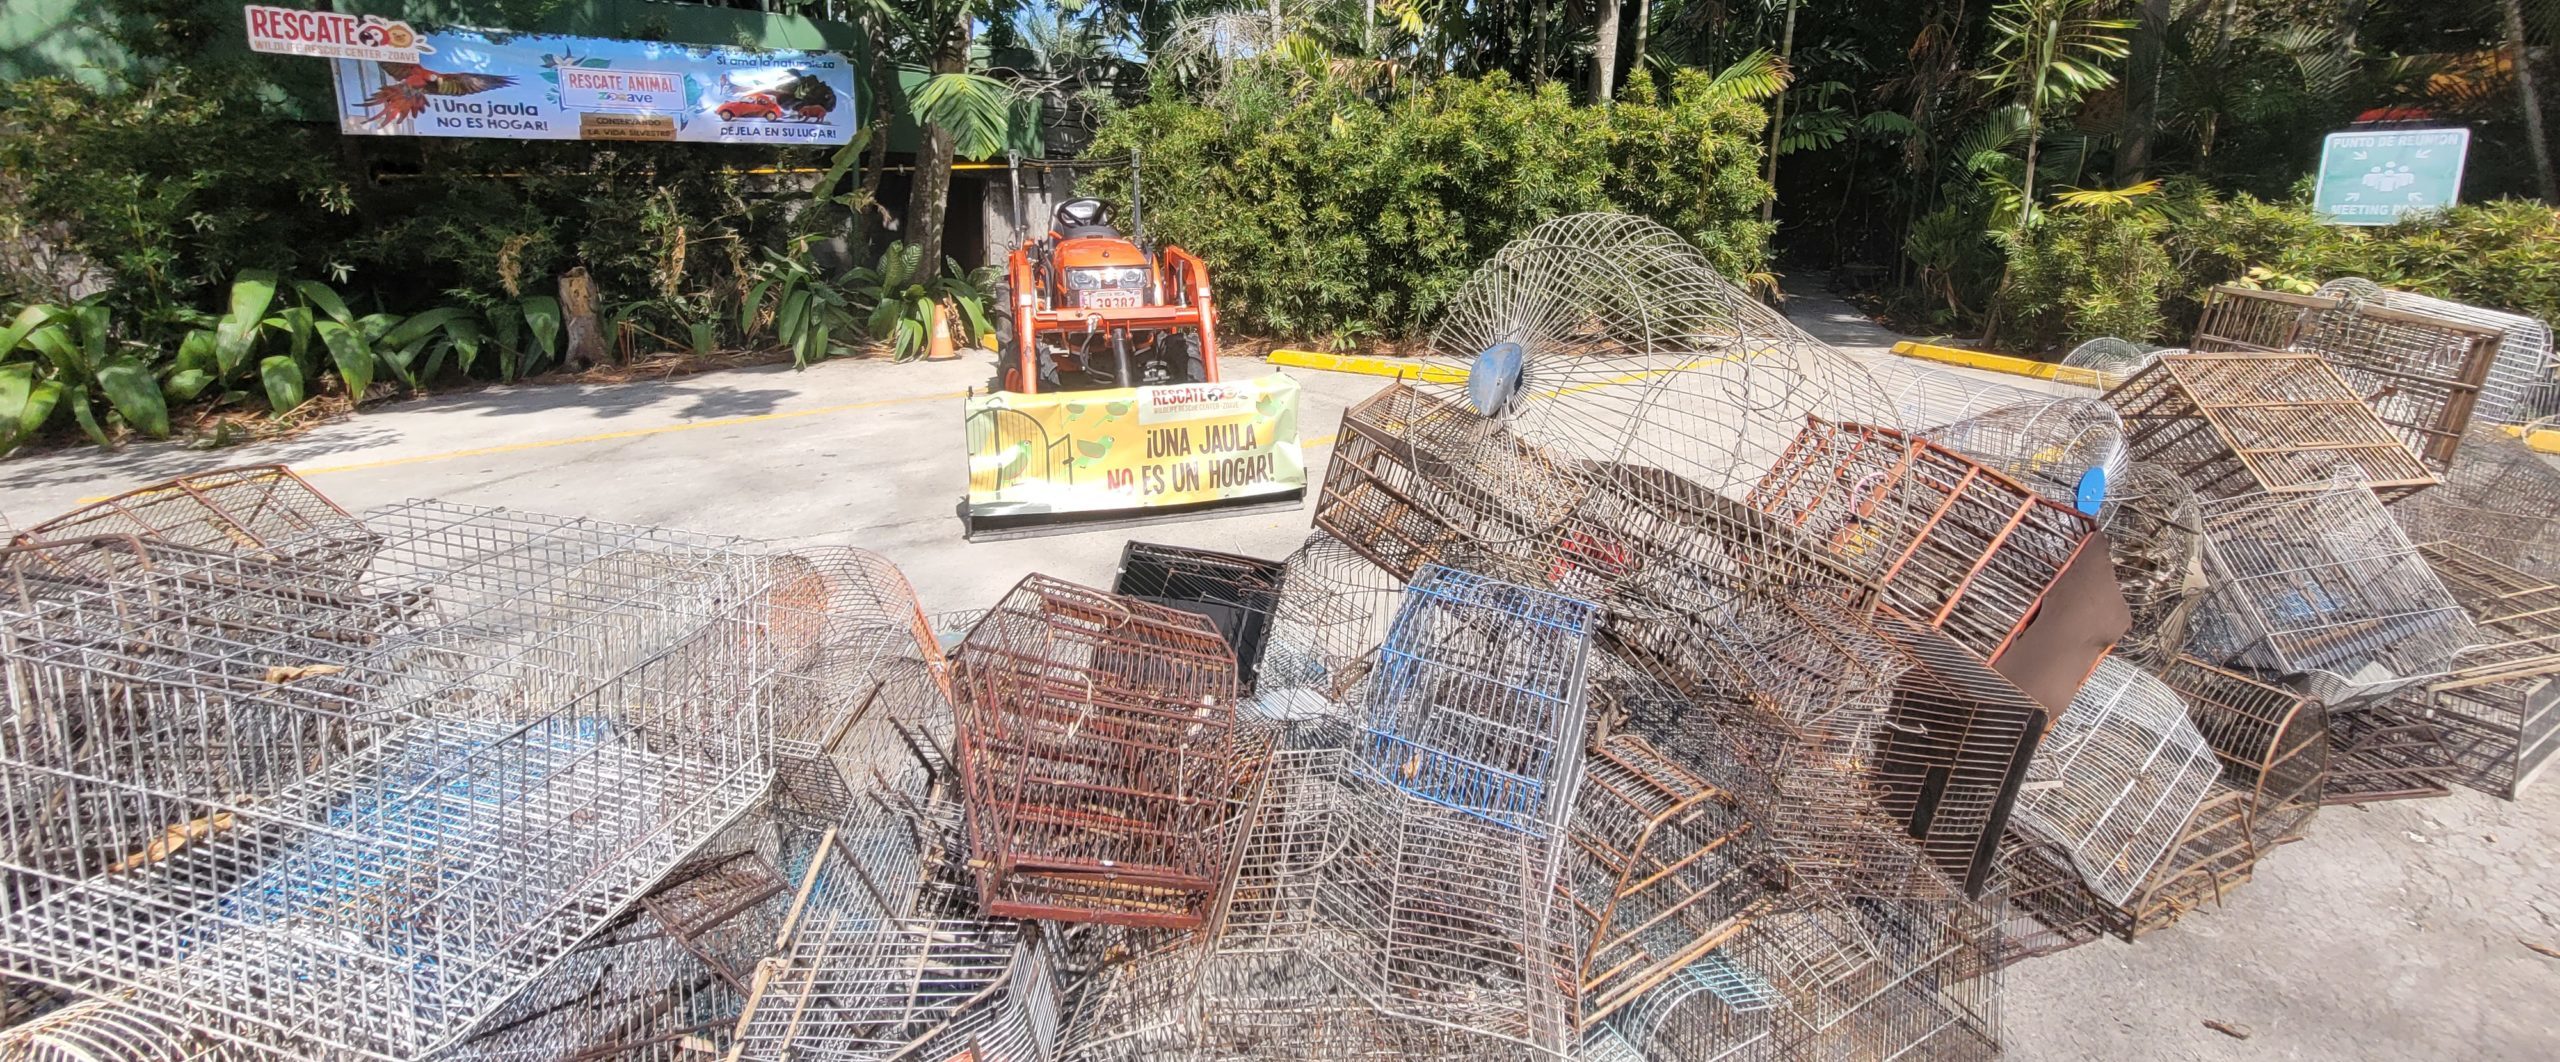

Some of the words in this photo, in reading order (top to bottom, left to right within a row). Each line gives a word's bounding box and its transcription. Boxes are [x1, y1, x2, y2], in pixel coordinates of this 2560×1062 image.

[251, 9, 357, 46] RESCATE
[304, 43, 342, 56] RESCUE
[344, 47, 382, 59] CENTER
[388, 52, 418, 62] ZOAVE
[568, 73, 623, 91] RESCATE
[628, 76, 677, 93] ANIMAL
[486, 100, 539, 118] jaula
[436, 117, 462, 128] NO
[466, 117, 484, 129] ES
[487, 119, 549, 132] HOGAR!
[764, 127, 779, 137] EN
[782, 127, 795, 138] SU
[797, 128, 837, 140] LUGAR!
[2333, 137, 2374, 149] PUNTO
[2377, 136, 2394, 147] DE
[2330, 204, 2390, 216] MEETING
[1152, 388, 1207, 406] RESCATE
[1146, 427, 1192, 459] ¡UNA
[1198, 423, 1258, 455] JAULA
[1107, 467, 1134, 496] NO
[1141, 464, 1166, 496] ES
[1171, 460, 1200, 493] UN
[1208, 452, 1276, 489] HOGAR!
